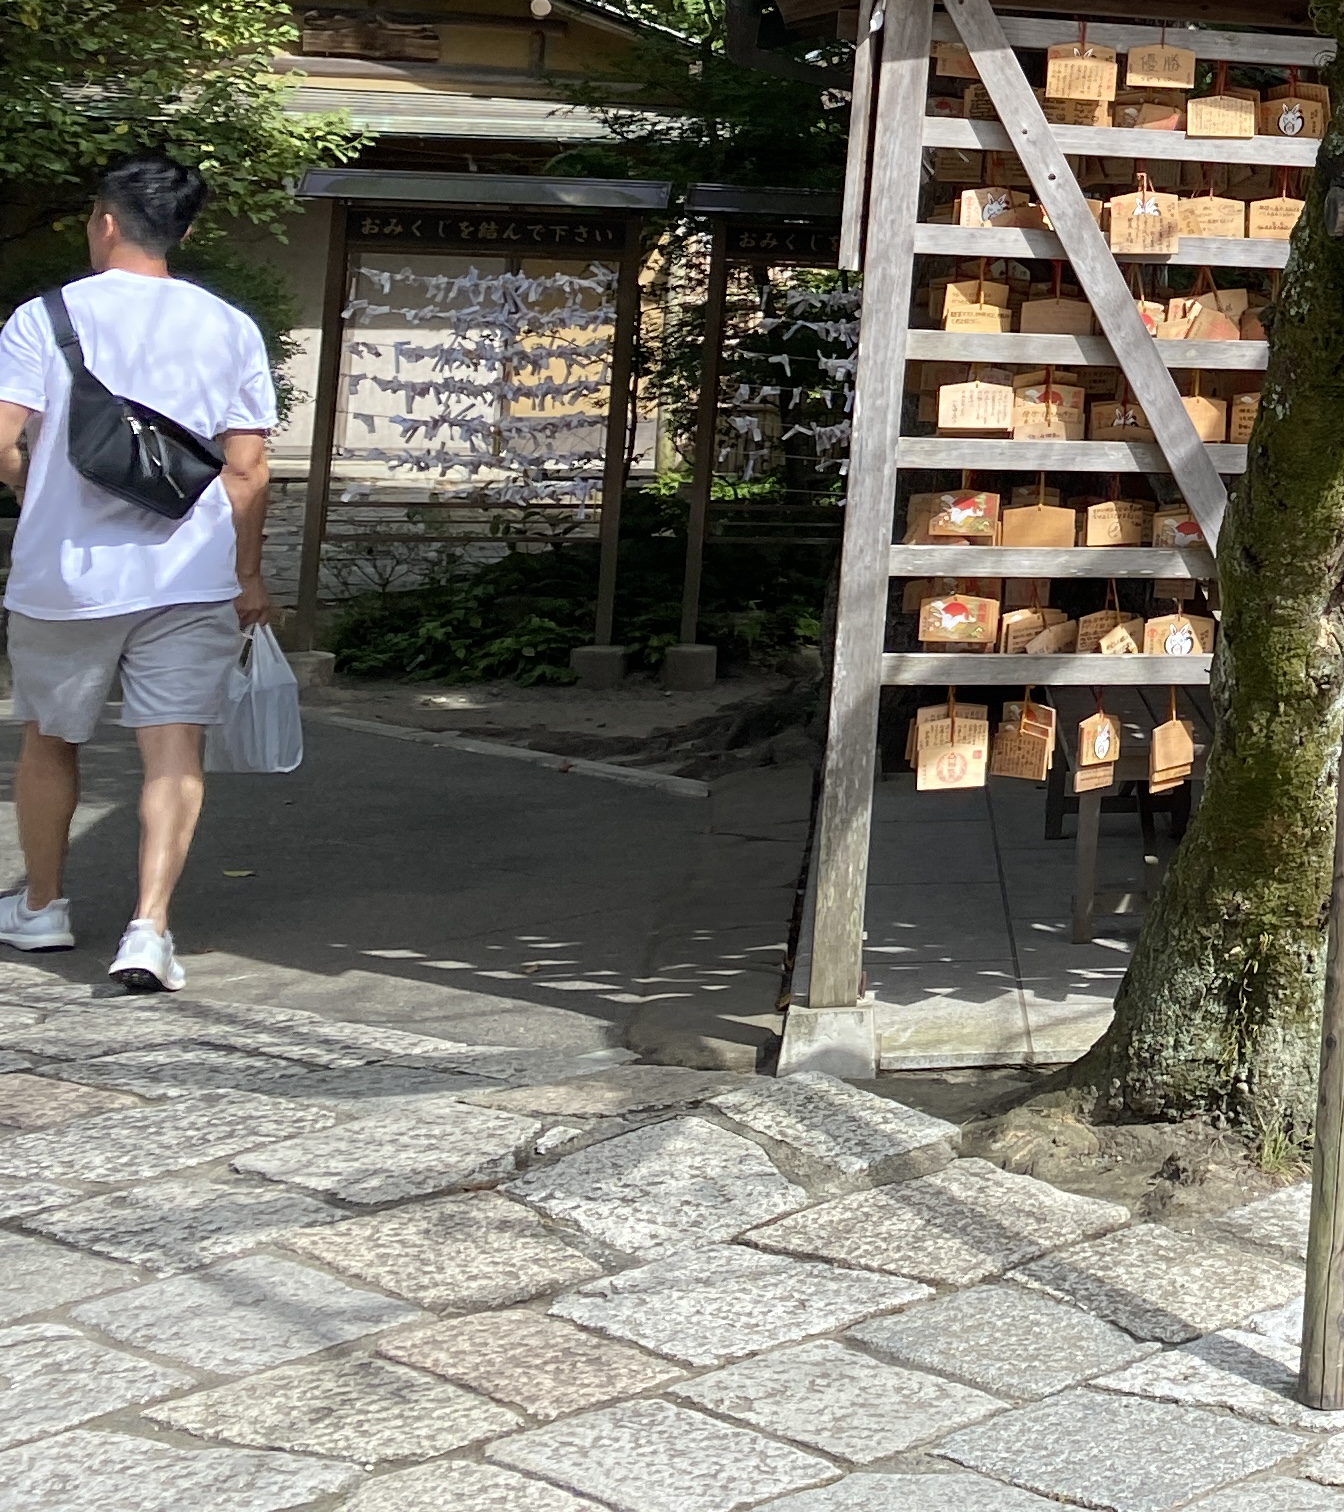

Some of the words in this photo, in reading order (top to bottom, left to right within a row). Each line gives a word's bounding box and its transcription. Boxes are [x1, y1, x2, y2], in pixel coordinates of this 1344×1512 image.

[361, 217, 613, 242] おみくじを結んで下さい
